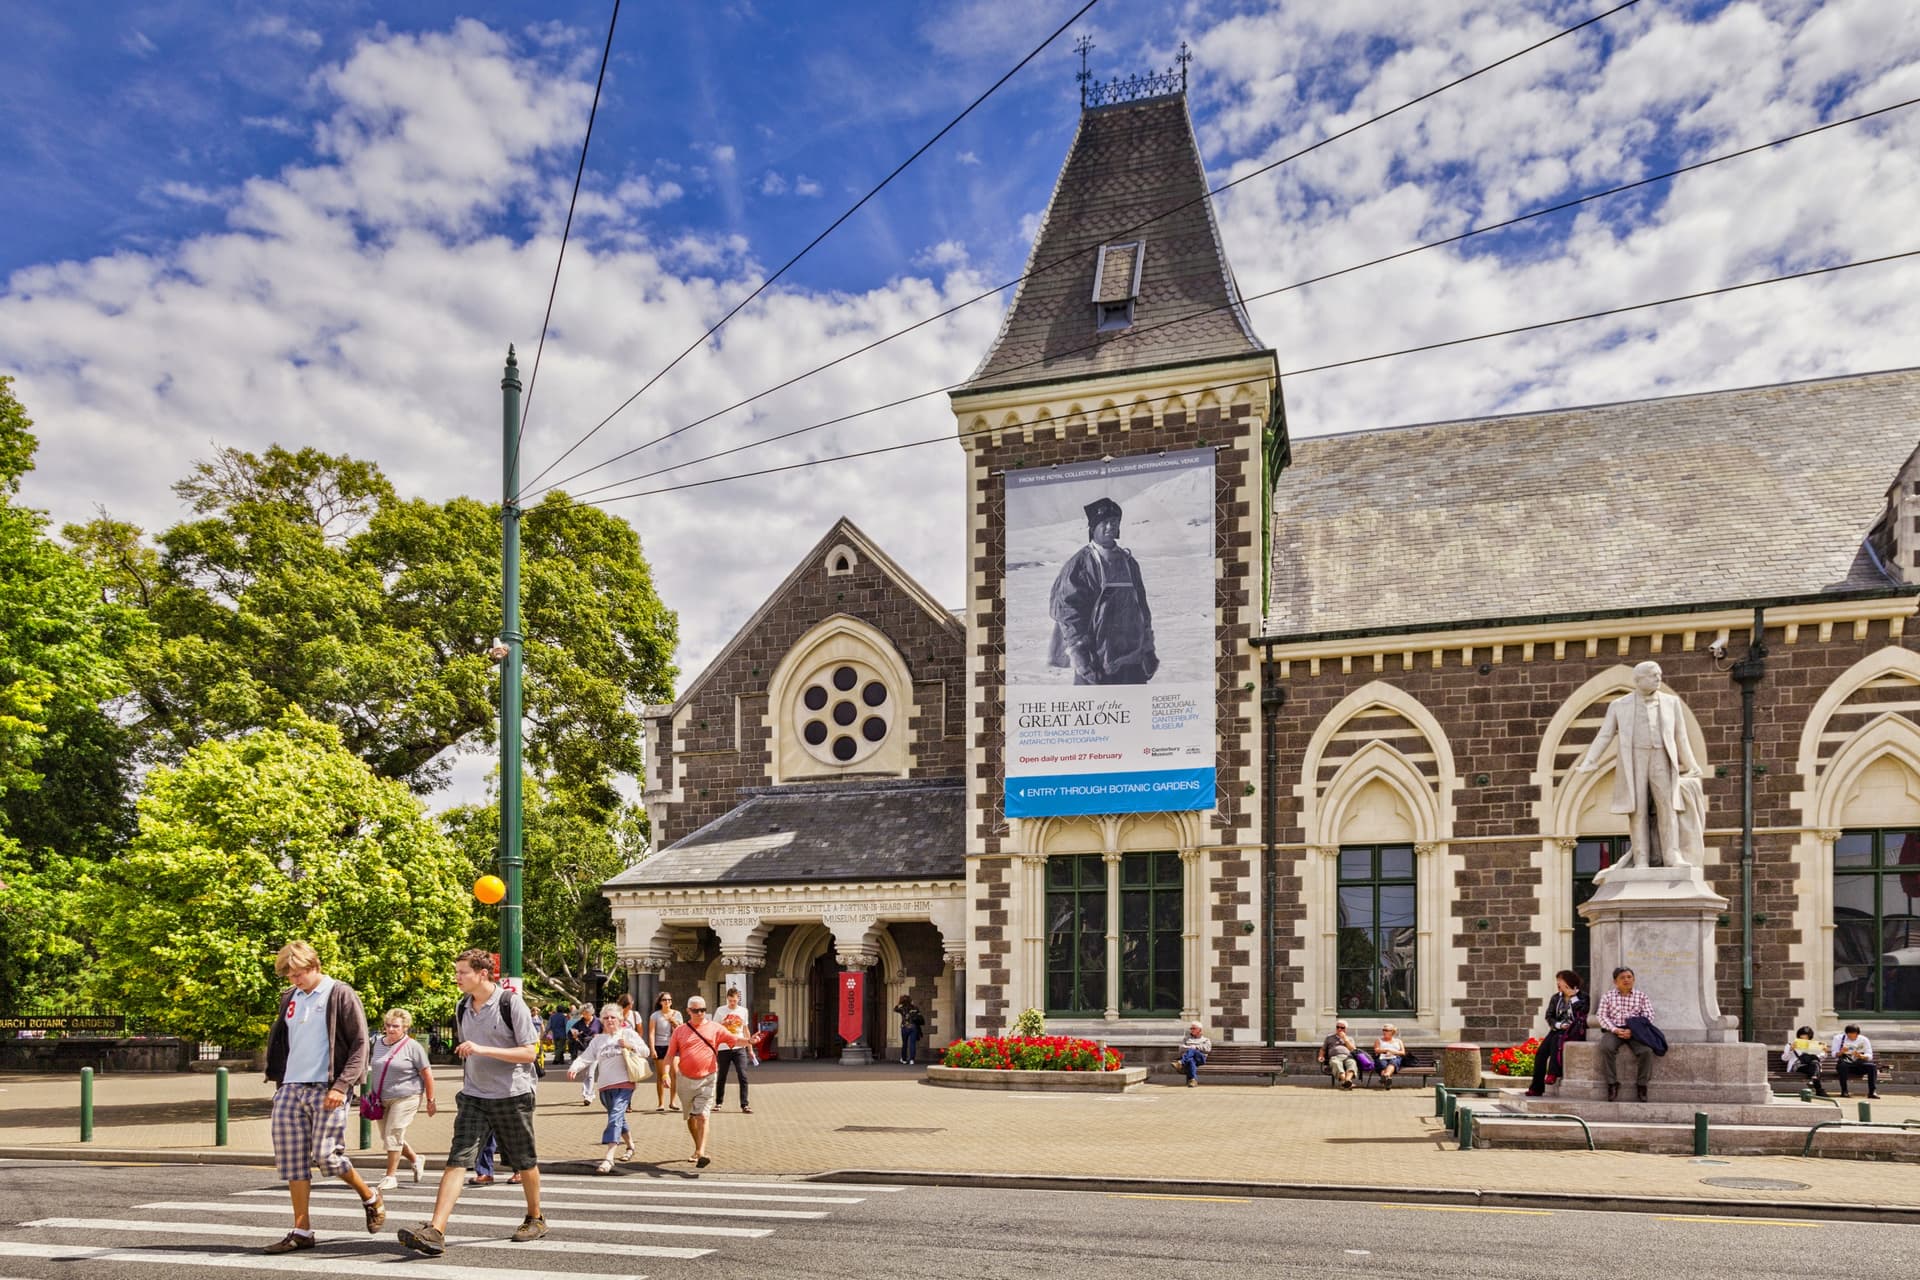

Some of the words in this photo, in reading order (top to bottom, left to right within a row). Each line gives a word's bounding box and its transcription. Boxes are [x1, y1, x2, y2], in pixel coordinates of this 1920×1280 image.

[1064, 470, 1099, 479] COLLECTION
[1107, 464, 1137, 473] EXCLUSIVE
[1138, 460, 1180, 470] INTERNATIONAL
[1180, 457, 1200, 465] VENUE
[1151, 694, 1181, 702] ROBERT
[1151, 699, 1197, 709] MCDOUGALL
[1018, 702, 1047, 713] THE
[1051, 700, 1095, 713] HEART
[1096, 701, 1108, 715] of
[1108, 700, 1123, 710] the
[1151, 708, 1185, 716] GALLERY
[1018, 713, 1071, 729] GREAT
[1074, 710, 1131, 726] ALONE
[1151, 713, 1200, 723] CANTERBURY
[1151, 722, 1184, 730] MUSEUM
[1044, 729, 1090, 738] SHACKLETON
[1018, 737, 1057, 746] ANTARCTIC
[1057, 735, 1110, 745] PHOTOGRAPHY
[1018, 756, 1040, 764] Open
[1041, 754, 1059, 763] daily
[1060, 753, 1077, 762] until
[1078, 753, 1088, 761] 27
[1089, 751, 1123, 761] February
[1027, 787, 1058, 797] ENTRY
[1060, 785, 1107, 796] THROUGH
[1109, 782, 1151, 793] BOTANIC
[1152, 780, 1200, 791] GARDENS
[738, 905, 751, 915] HIS
[753, 905, 771, 914] WAYS
[774, 905, 787, 913] BUT
[807, 904, 832, 912] LITTLE
[880, 902, 902, 911] HEARD
[914, 901, 930, 911] HIM
[711, 917, 758, 927] CANTERBURY
[824, 914, 857, 924] MUSEUM
[859, 914, 875, 922] 1870
[847, 990, 855, 1016] open
[29, 1018, 68, 1028] BOTANIC
[71, 1018, 116, 1028] GARDENS
